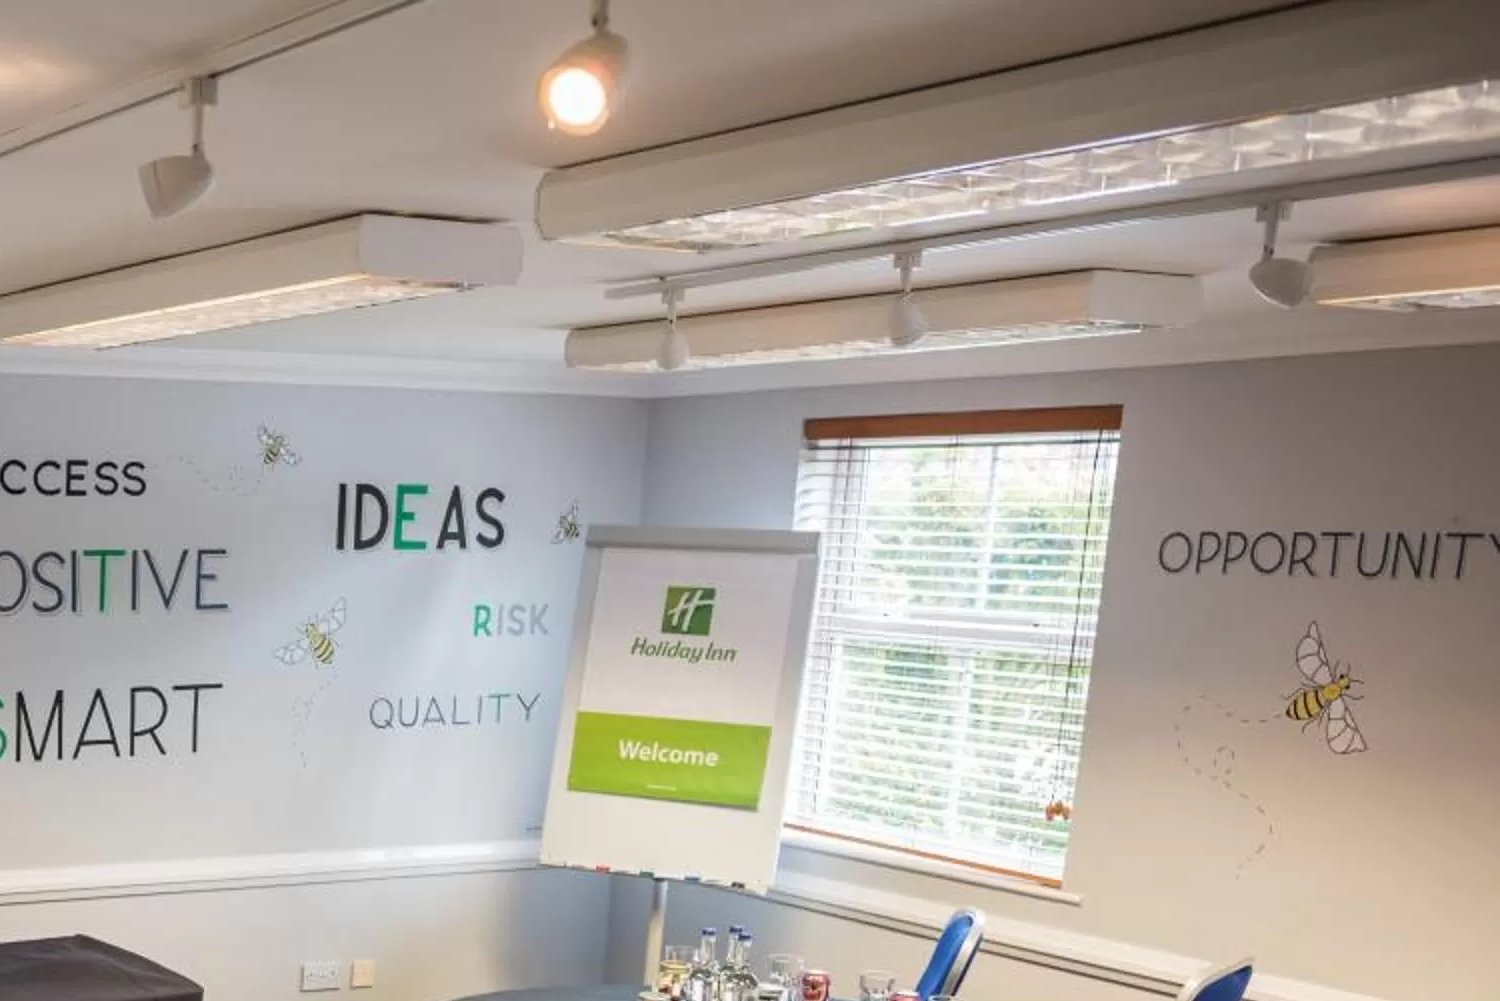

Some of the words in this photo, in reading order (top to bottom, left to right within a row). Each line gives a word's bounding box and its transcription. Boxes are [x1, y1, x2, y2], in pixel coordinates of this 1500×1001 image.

[335, 482, 506, 552] IDEAS
[471, 602, 548, 639] RISK
[630, 636, 703, 662] Holiday
[705, 642, 737, 662] Inn
[369, 693, 540, 729] QUALITY
[618, 739, 719, 767] Welcome
